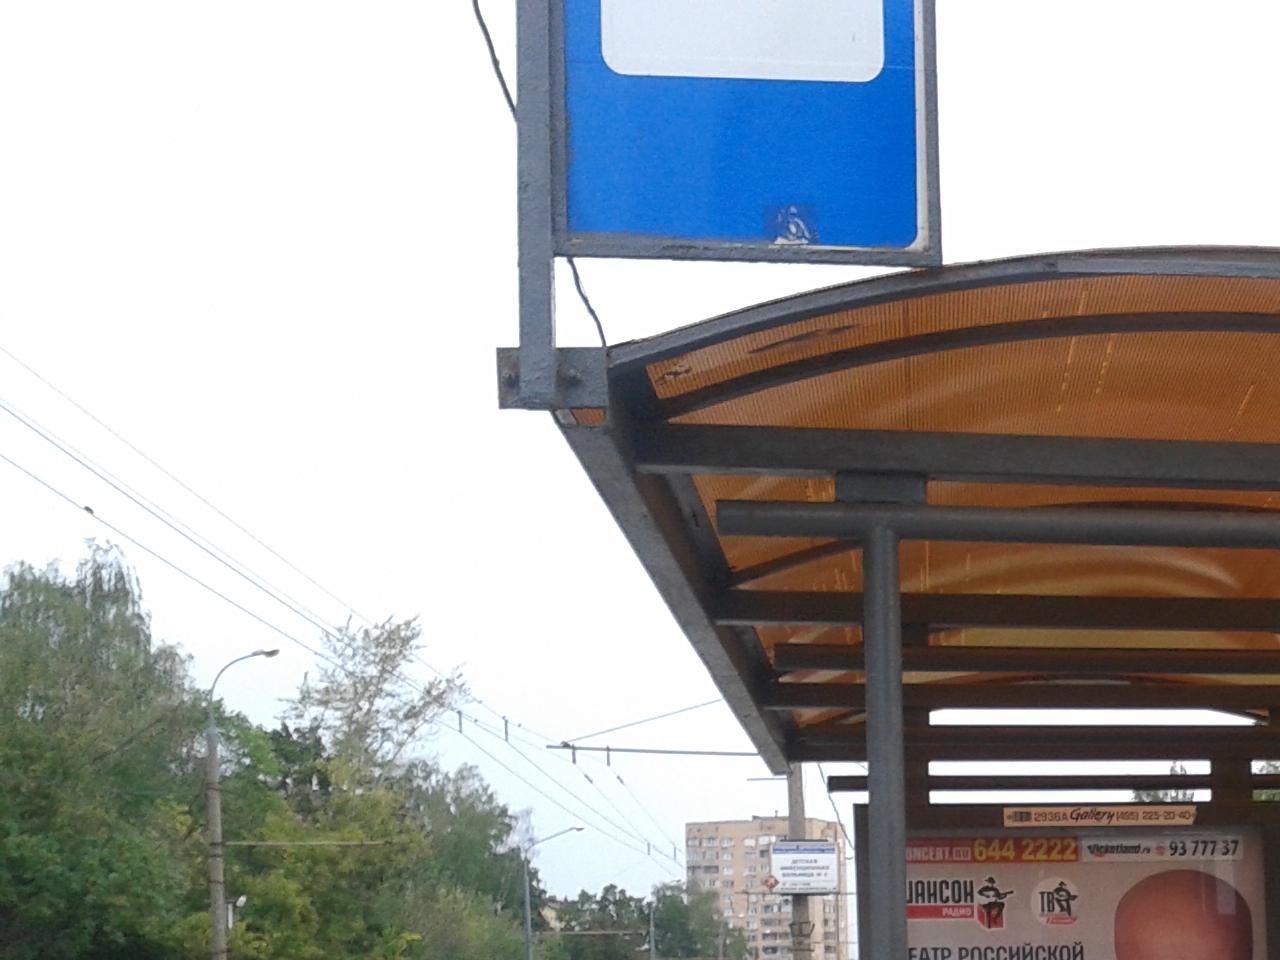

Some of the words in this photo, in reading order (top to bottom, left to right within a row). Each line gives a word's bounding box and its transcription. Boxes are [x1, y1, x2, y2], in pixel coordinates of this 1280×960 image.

[1070, 808, 1114, 824] Gallery
[974, 839, 1016, 861] 644
[1022, 838, 1077, 861] 2222
[1169, 841, 1187, 857] 93
[1191, 841, 1217, 857] 777
[1221, 840, 1239, 857] 37
